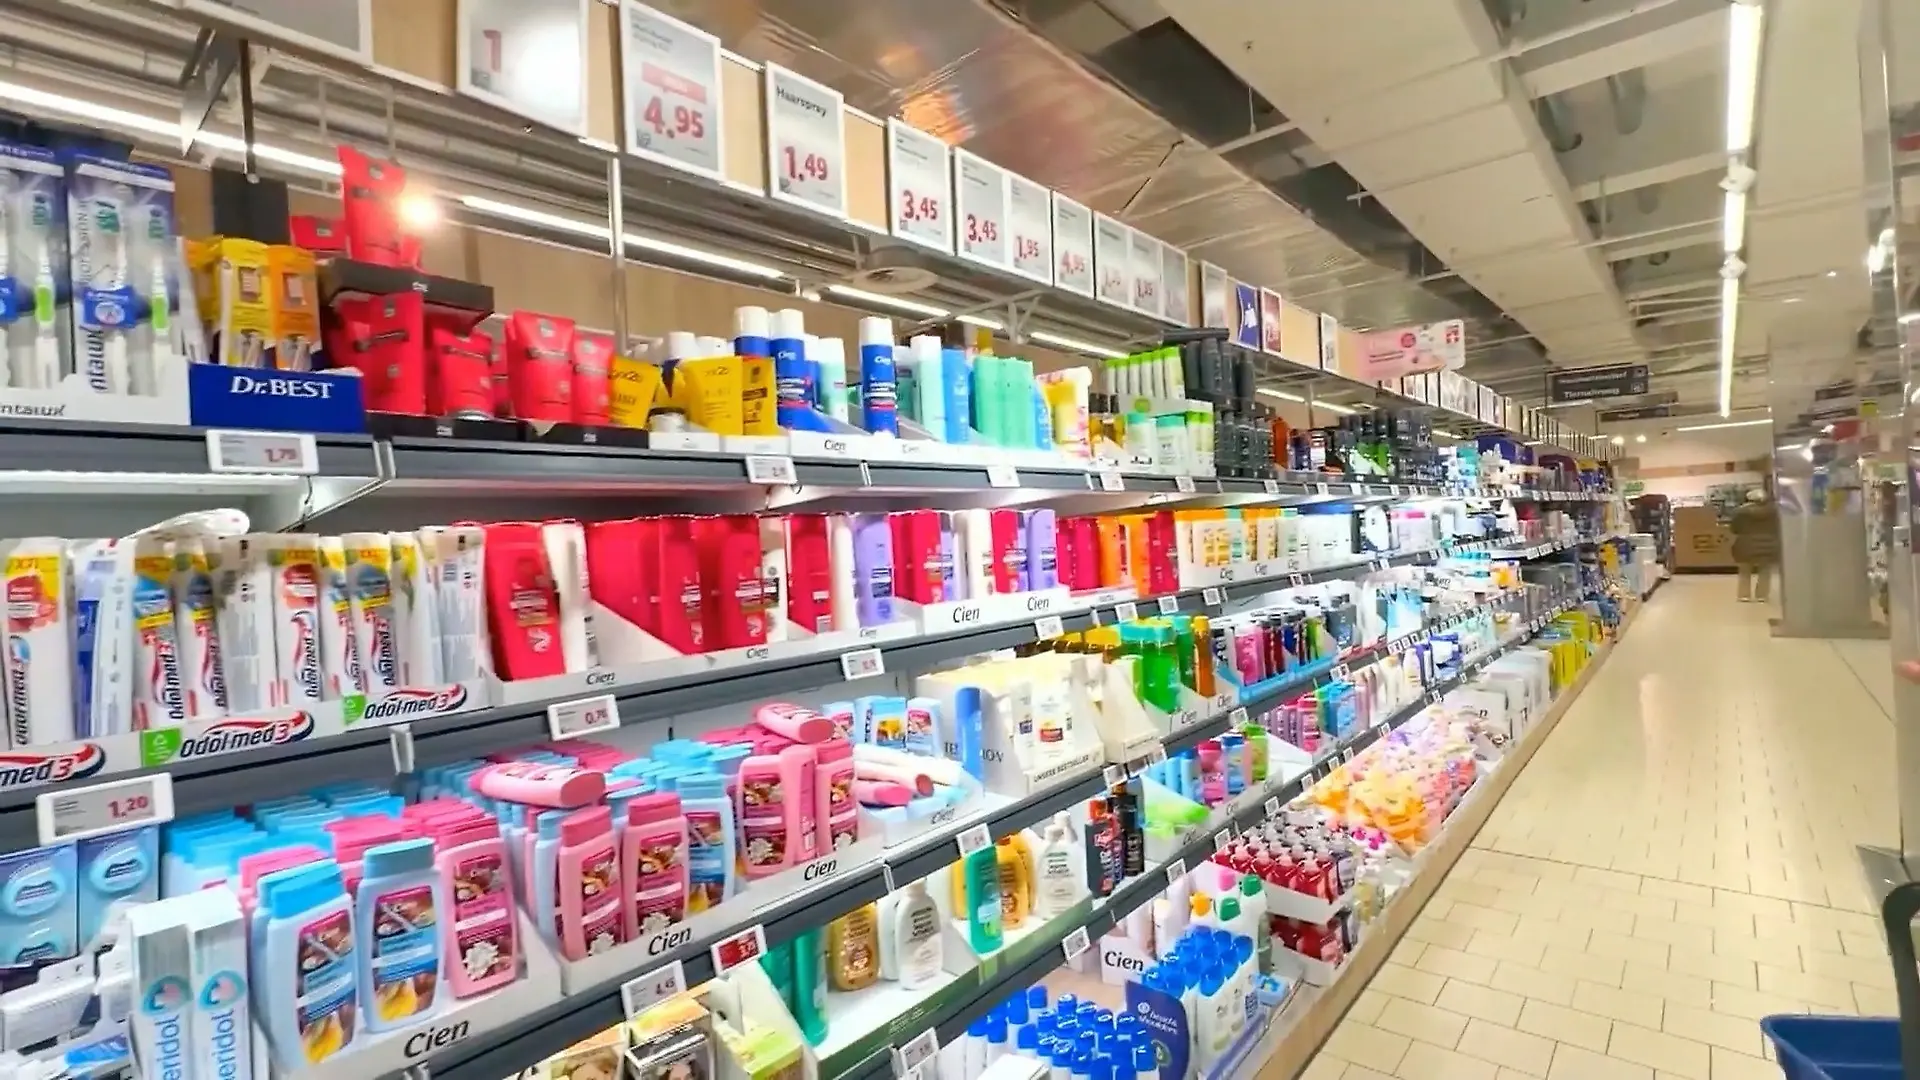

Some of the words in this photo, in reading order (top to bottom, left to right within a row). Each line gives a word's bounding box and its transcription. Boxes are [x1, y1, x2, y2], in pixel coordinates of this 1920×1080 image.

[776, 84, 828, 117] Haarspray
[643, 96, 705, 139] 4.95
[784, 146, 829, 181] 1.49
[902, 189, 939, 221] 3.45
[967, 213, 997, 243] 3.45
[229, 375, 335, 399] Dr.BEST
[952, 605, 981, 624] Cien
[1026, 596, 1050, 612] Cien
[804, 857, 838, 881] Cien
[649, 926, 693, 957] Cien
[1104, 950, 1145, 973] Cien
[211, 1008, 237, 1080] eridol
[404, 1019, 470, 1059] Cien
